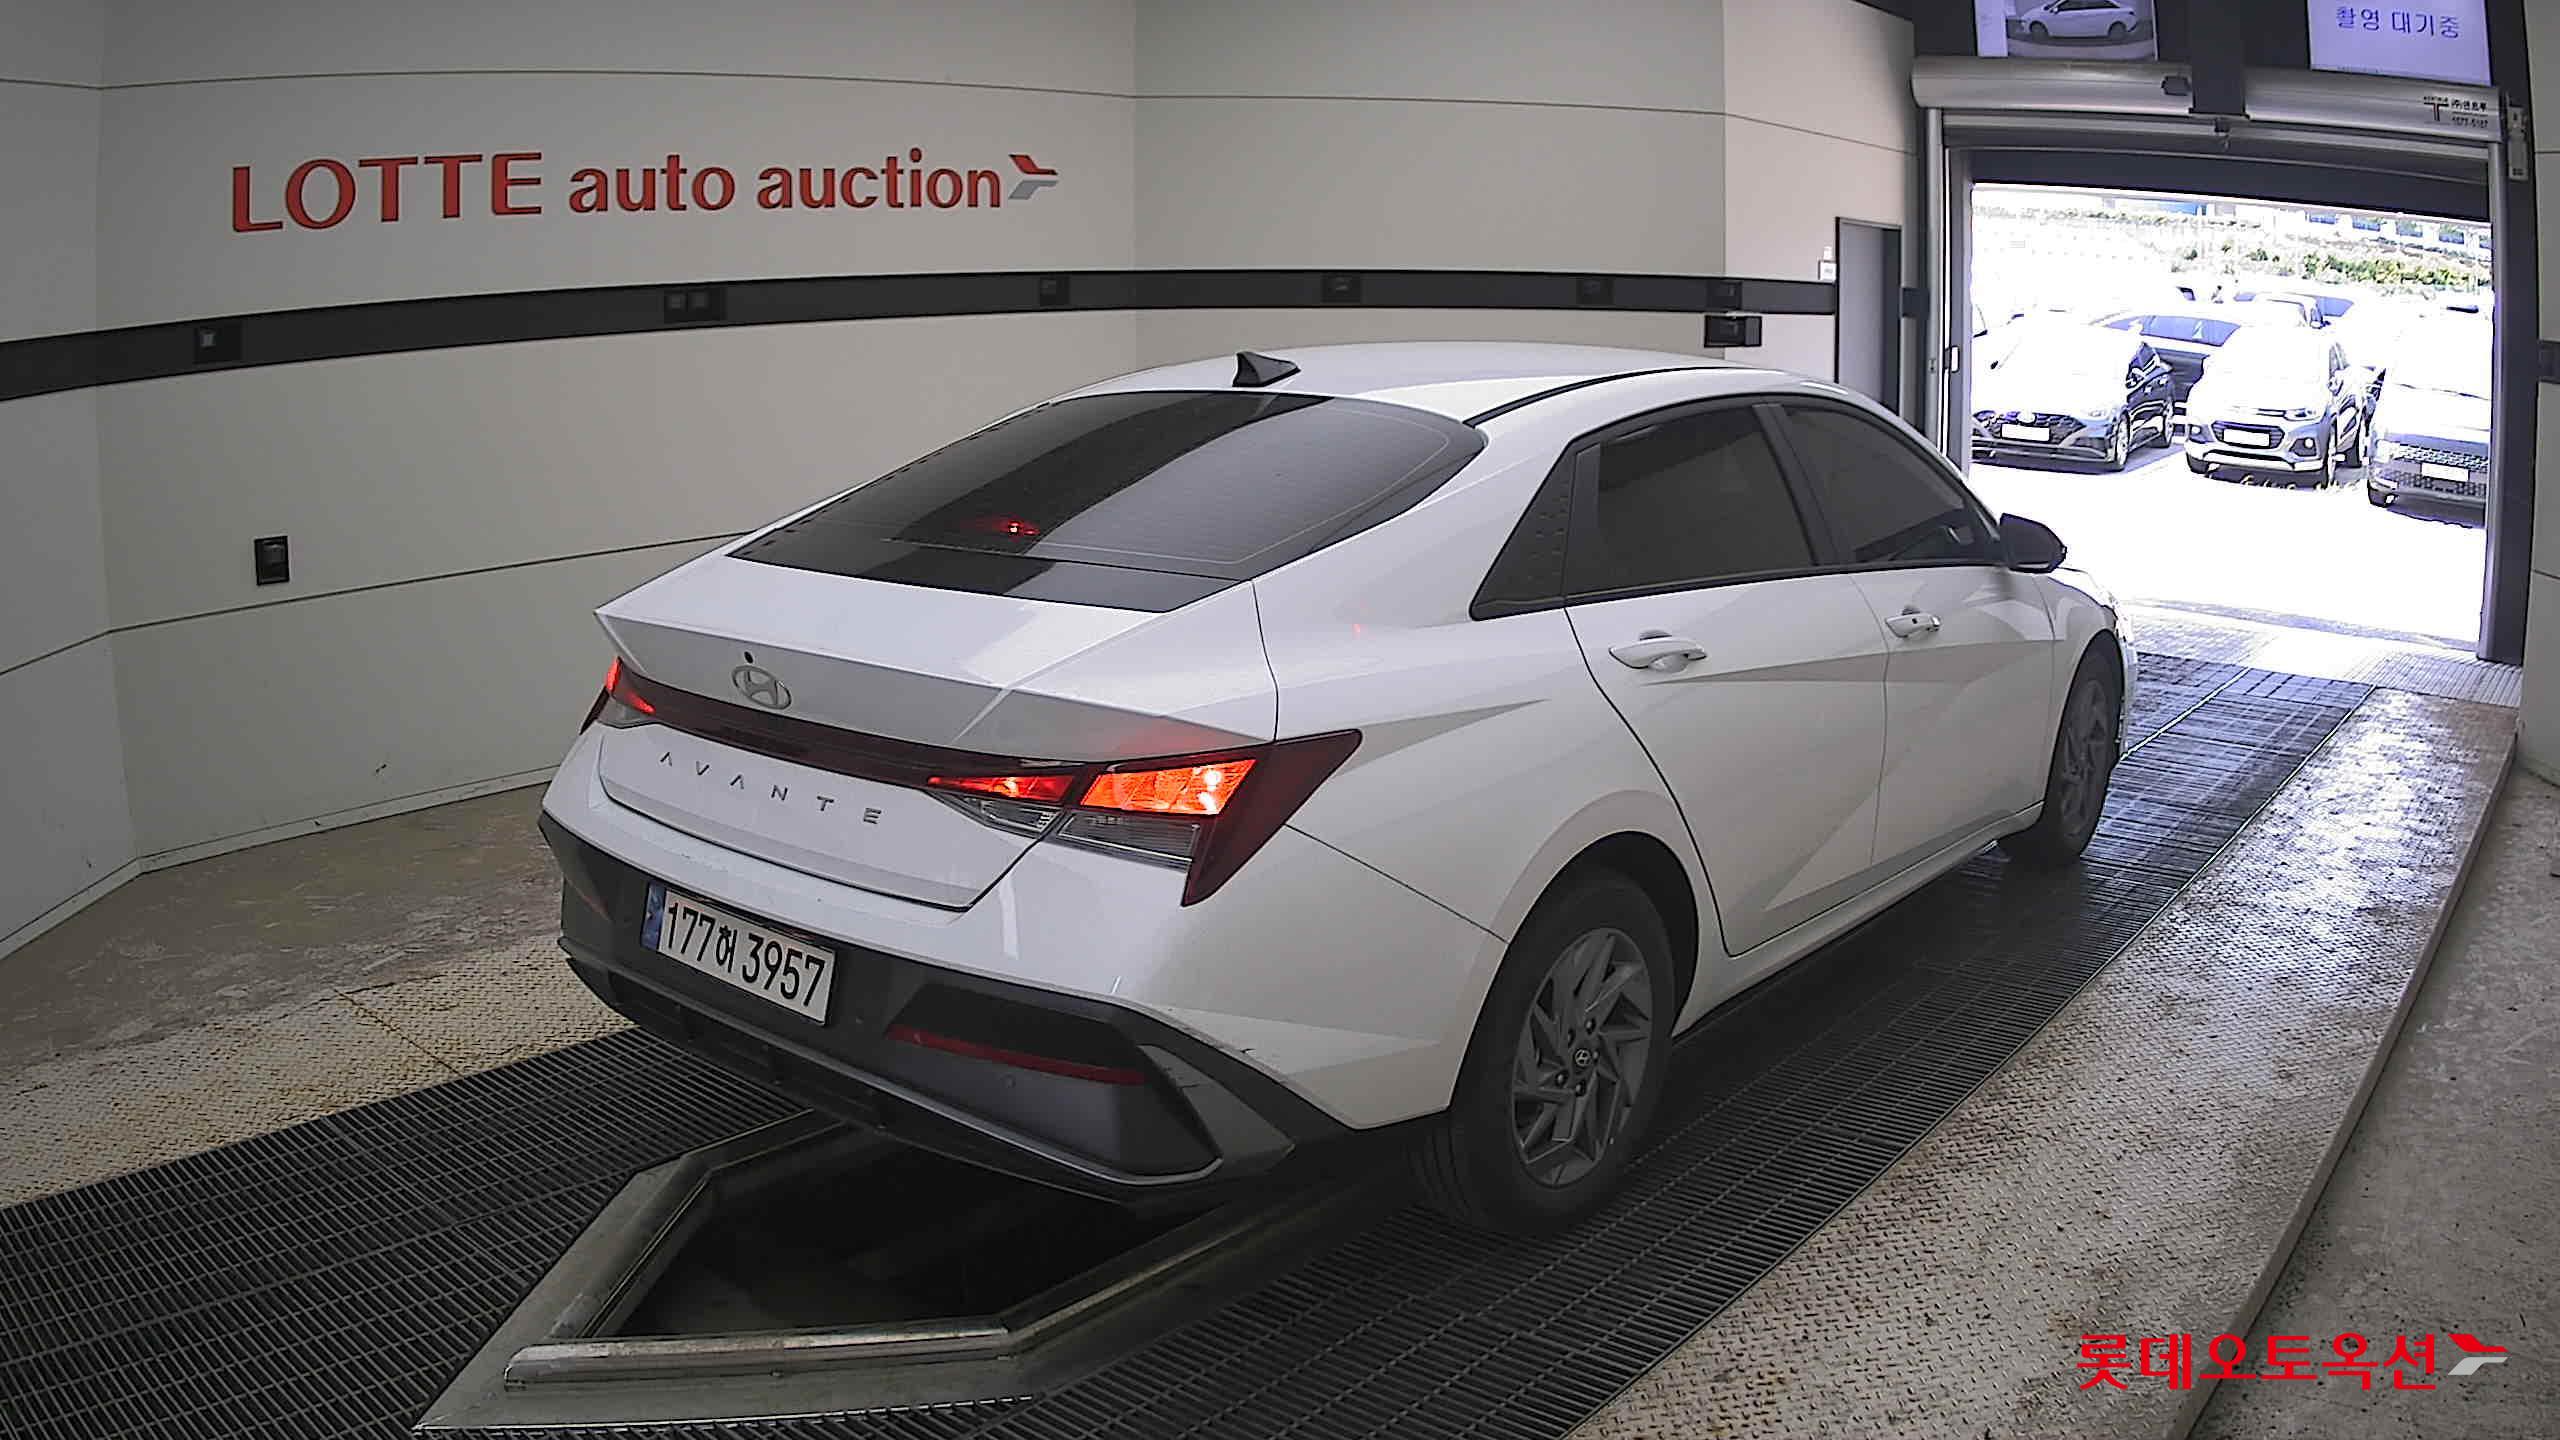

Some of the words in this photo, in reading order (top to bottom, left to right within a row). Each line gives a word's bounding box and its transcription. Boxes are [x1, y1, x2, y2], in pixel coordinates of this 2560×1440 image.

[2336, 6, 2380, 32] 촬영
[2391, 11, 2460, 39] 대기중
[233, 151, 543, 233] LOTTE
[568, 153, 737, 214] auto
[757, 147, 1001, 210] auction
[659, 751, 882, 825] AVANTE
[667, 902, 738, 974] 177허
[741, 932, 826, 1007] 3957
